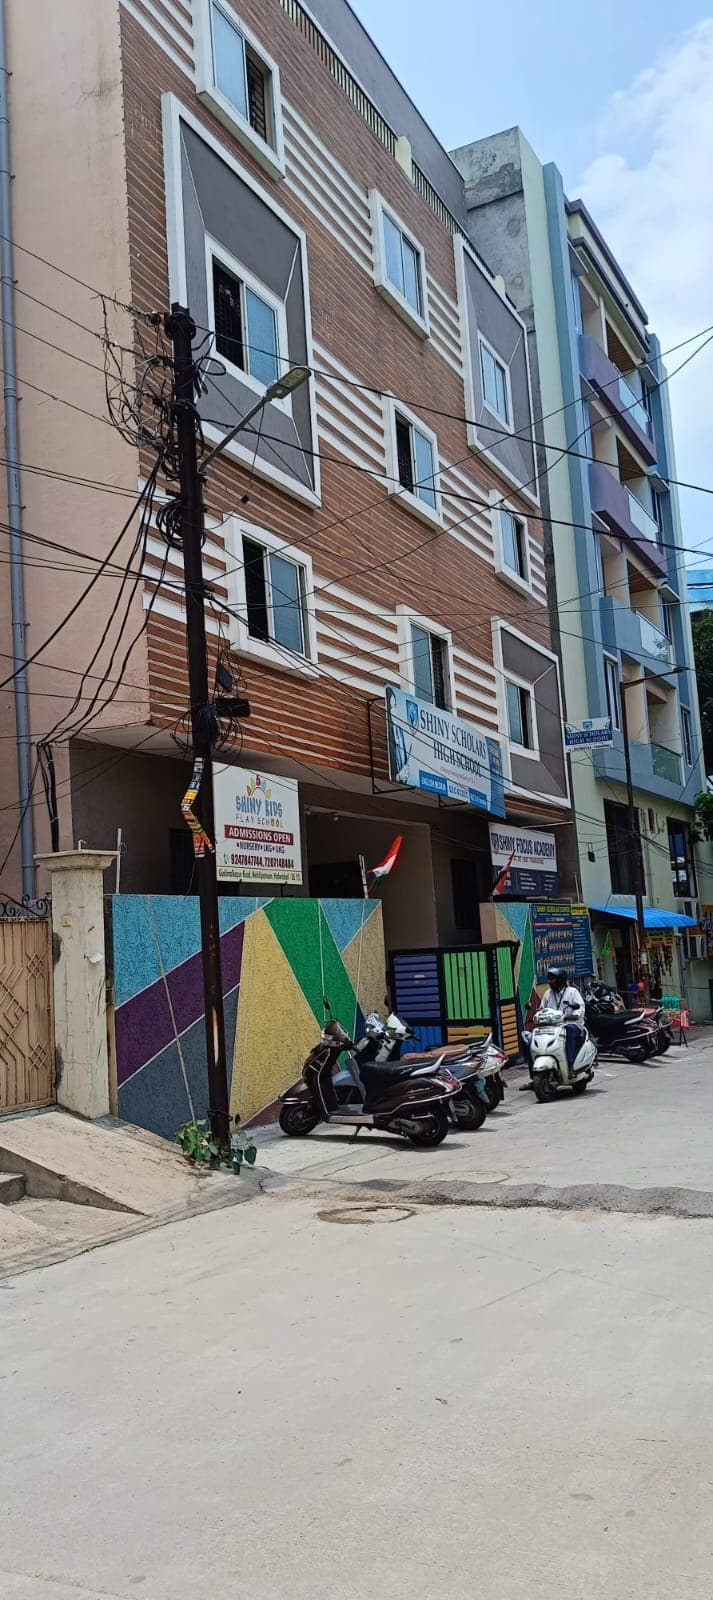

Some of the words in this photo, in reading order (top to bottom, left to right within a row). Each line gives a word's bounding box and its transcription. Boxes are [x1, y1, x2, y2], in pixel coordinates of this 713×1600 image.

[420, 709, 449, 740] SHINY
[451, 724, 487, 759] SCHOLARS
[433, 741, 456, 766] HIGH
[456, 752, 482, 778] SCHOOL
[235, 795, 262, 815] SHINY
[265, 799, 283, 818] KIDS
[235, 813, 254, 823] PLAY
[257, 817, 284, 828] SCHOOL
[229, 827, 272, 842] ADMISSIONS
[273, 833, 291, 843] OPEN
[499, 834, 515, 852] SHINY
[516, 837, 534, 855] FOCUS
[534, 840, 555, 857] ACADEMY
